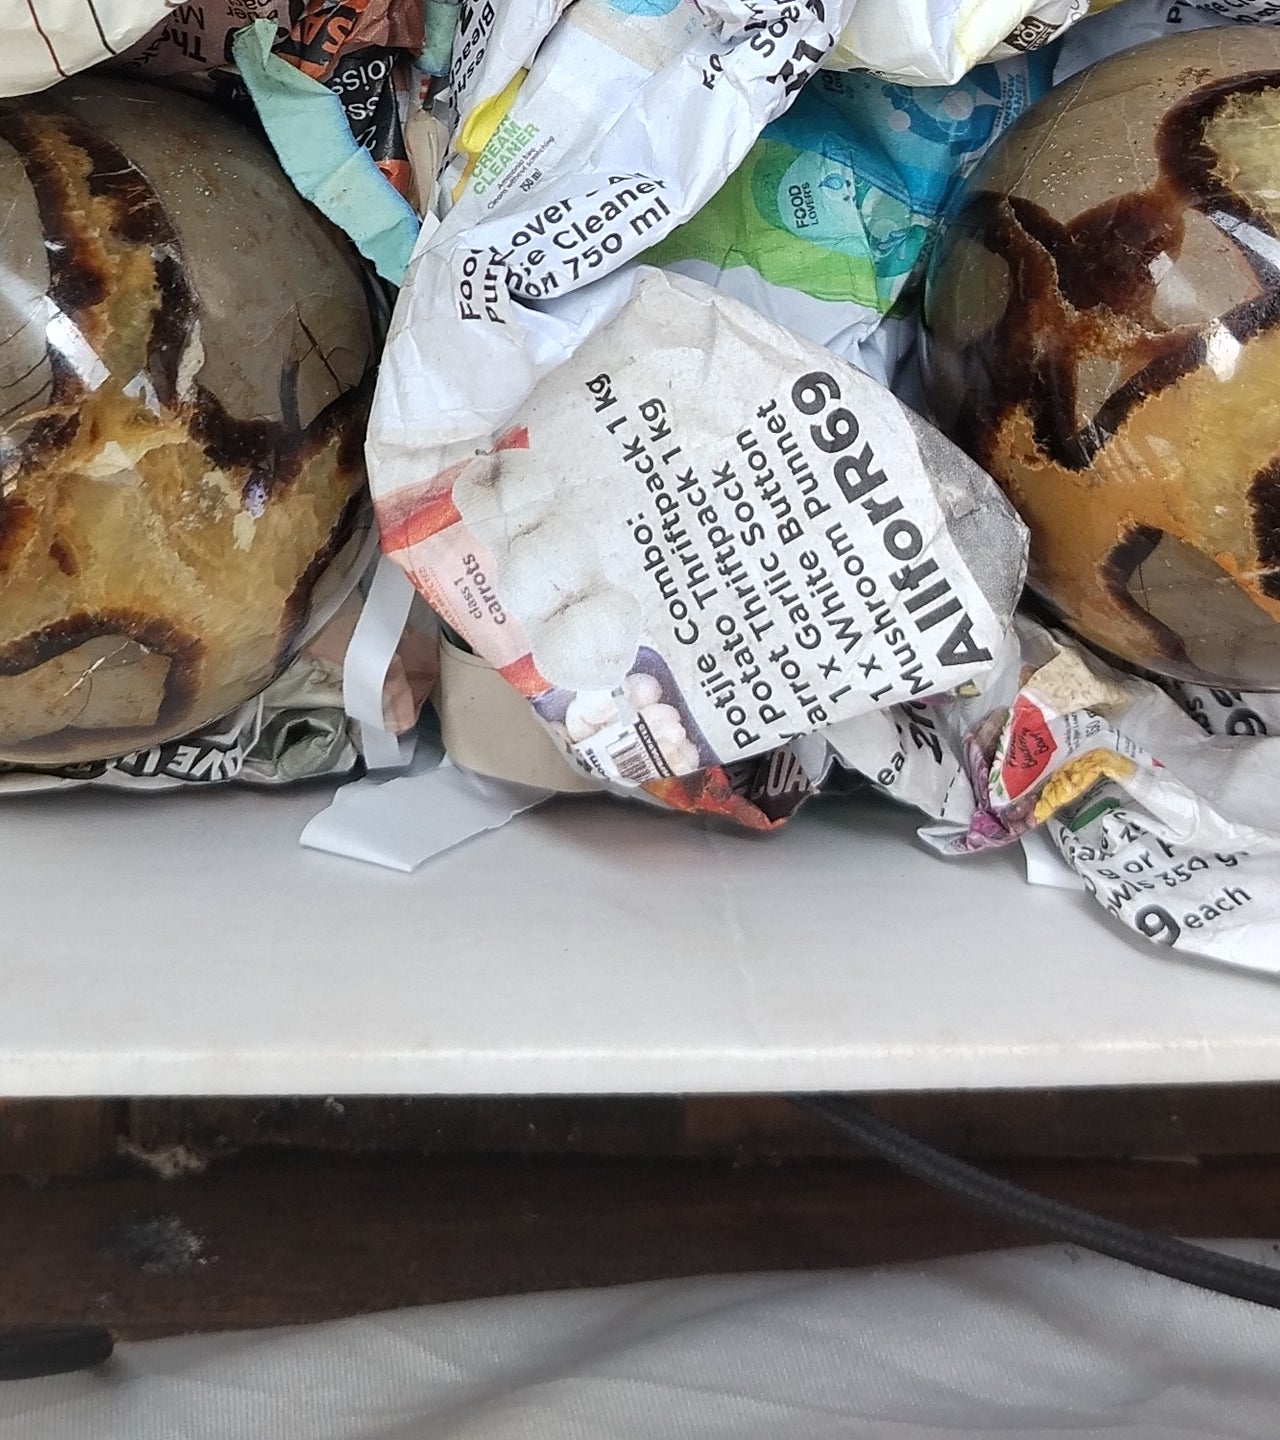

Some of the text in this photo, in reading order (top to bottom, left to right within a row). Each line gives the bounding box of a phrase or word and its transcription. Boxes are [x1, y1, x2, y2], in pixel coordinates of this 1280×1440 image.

[1013, 19, 1045, 48] YOU
[472, 120, 523, 180] CREAM
[473, 122, 540, 195] CLEANER
[561, 232, 623, 282] 750
[628, 195, 671, 237] ml
[788, 184, 810, 229] FOOD
[584, 372, 788, 726] Potato Thriftpack 1 kg
[755, 397, 935, 697] Mushroom Punnet
[791, 370, 994, 668] AllforR69
[460, 585, 484, 620] class
[462, 553, 508, 625] carrots
[637, 397, 832, 731] arrot Thriftpack 1 kg
[710, 459, 855, 705] 1 x Garlic Sock
[735, 427, 895, 705] 1 x White Button
[626, 512, 761, 750] Potjie Combo:
[1182, 884, 1253, 930] each
